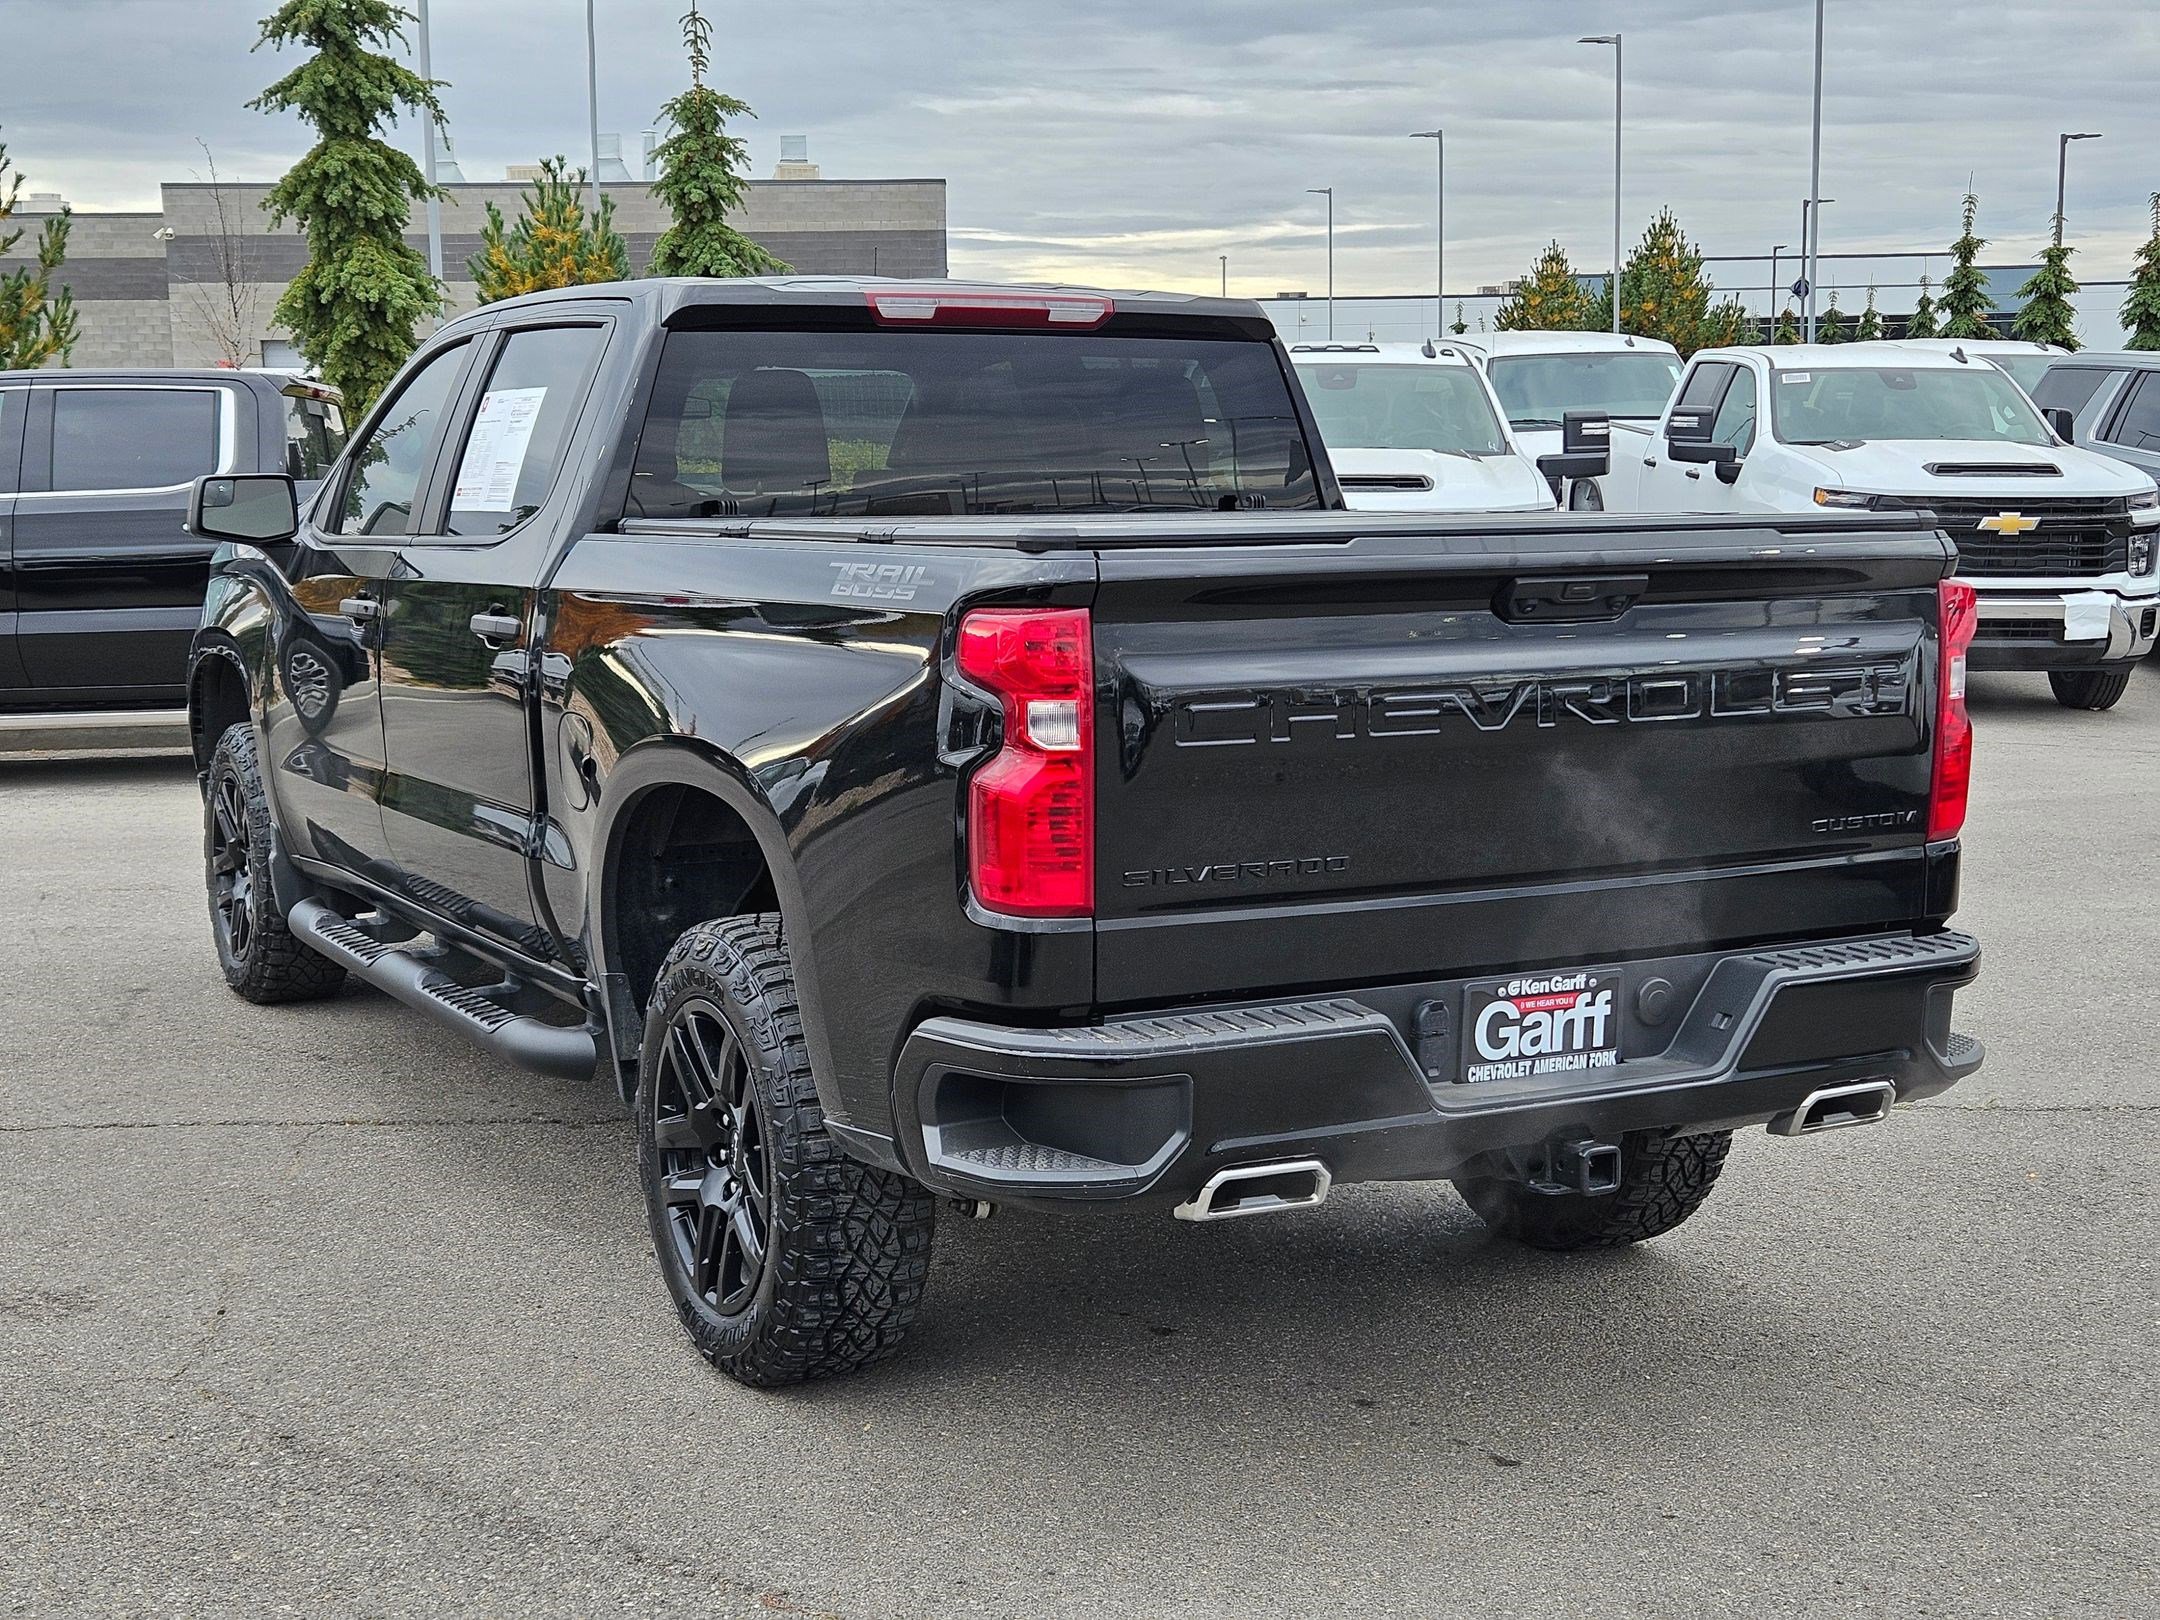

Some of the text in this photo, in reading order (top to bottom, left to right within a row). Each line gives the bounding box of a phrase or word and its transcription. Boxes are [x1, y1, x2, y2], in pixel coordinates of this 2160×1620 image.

[829, 562, 936, 586] TRAIL
[831, 581, 918, 601] BOSS
[1174, 661, 1902, 746] CHEVROLET
[1811, 810, 1918, 832] CUSTOM
[1122, 855, 1350, 887] SILVERADO
[1536, 999, 1555, 1008] HEAR
[1555, 997, 1569, 1006] YOU
[1474, 989, 1612, 1062] Garff
[1467, 1050, 1617, 1083] CHEVROLET AMERICAN FORK
